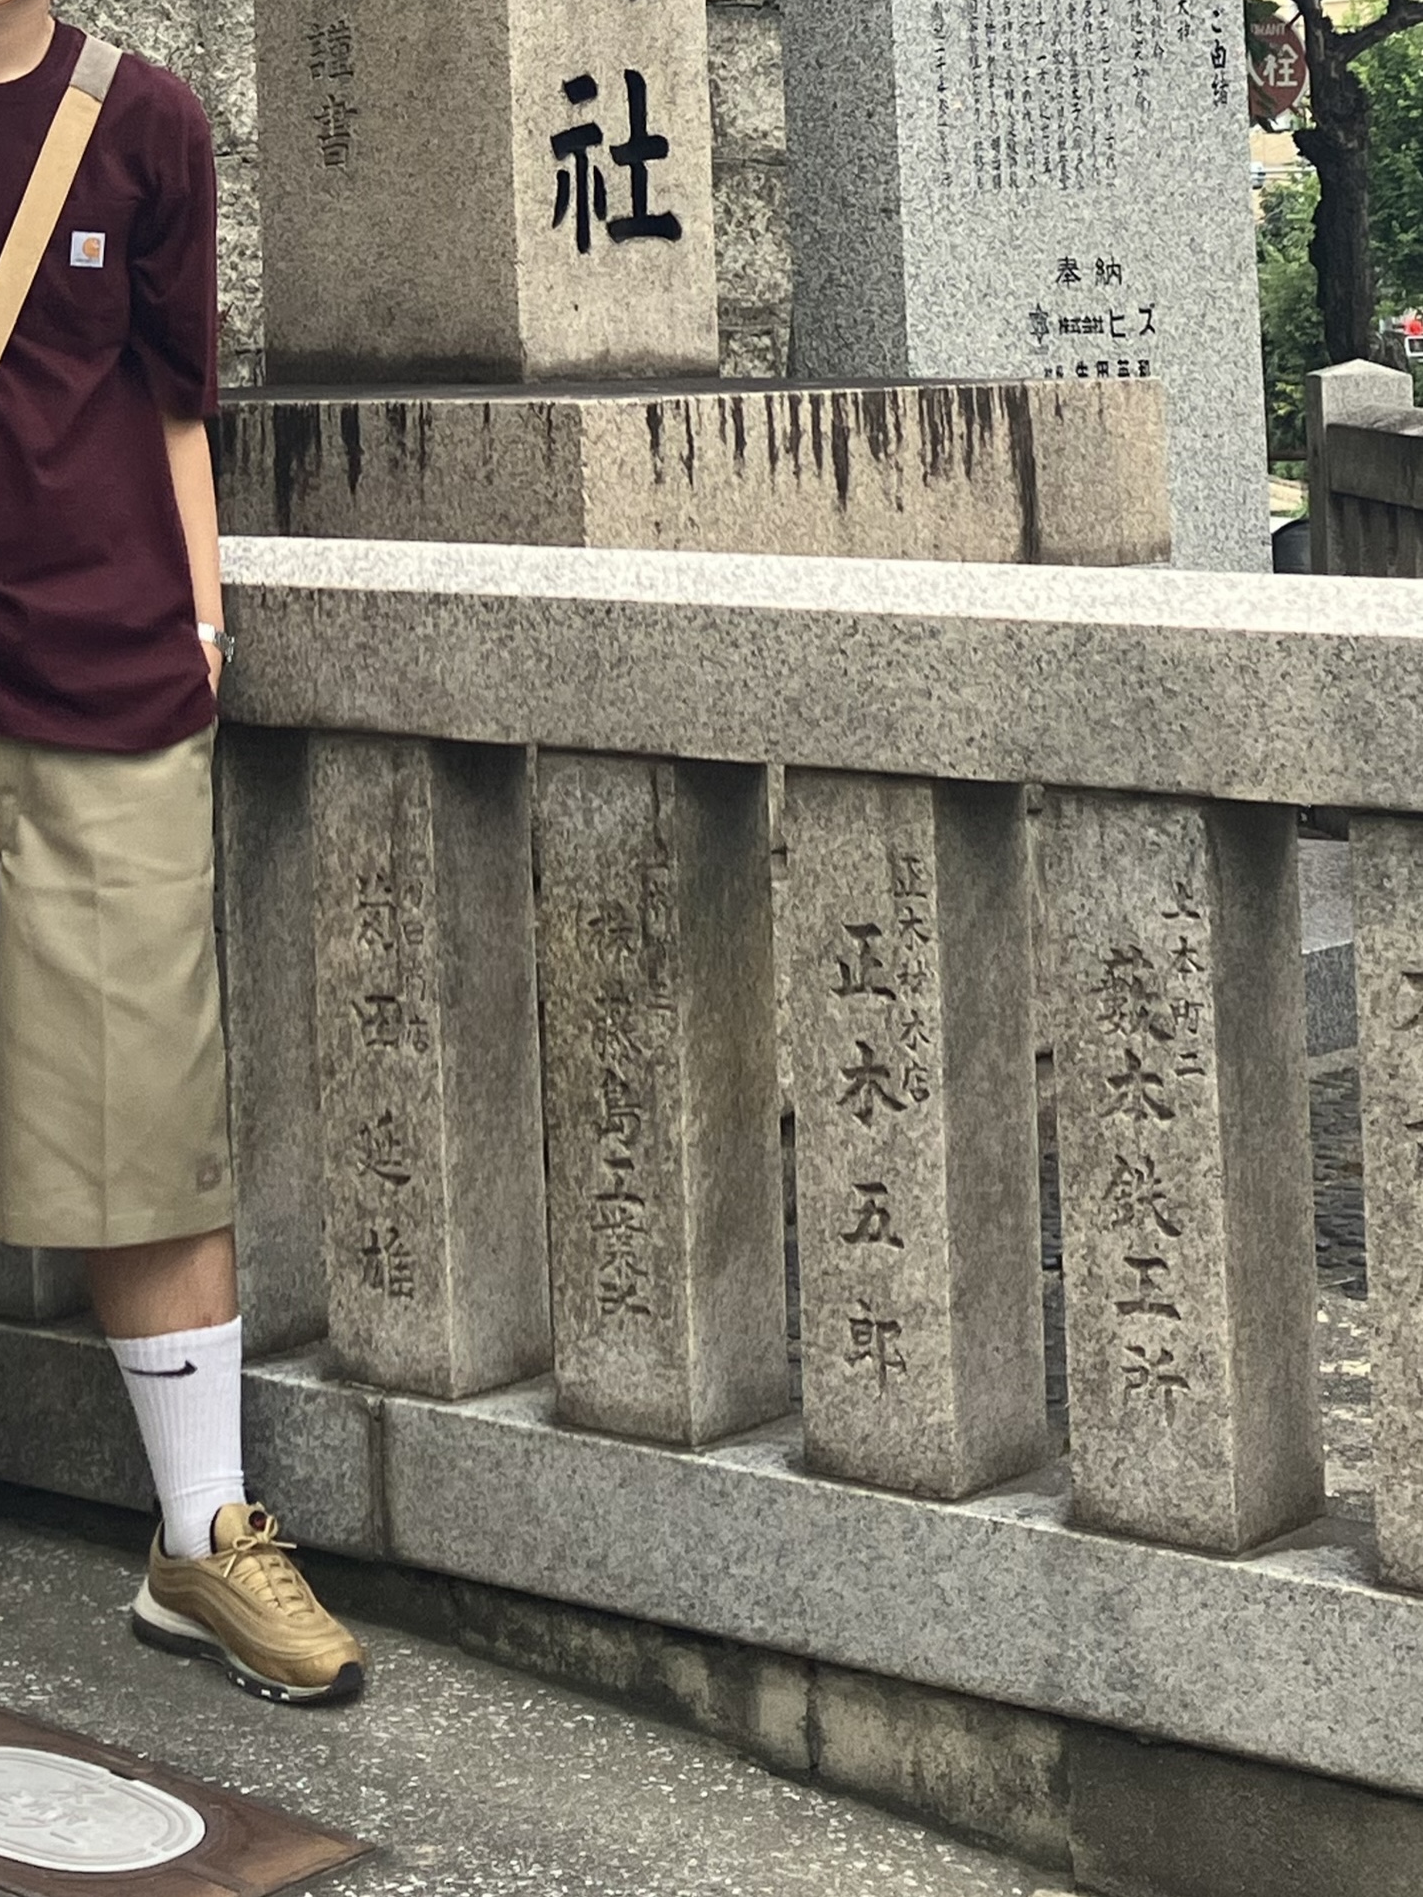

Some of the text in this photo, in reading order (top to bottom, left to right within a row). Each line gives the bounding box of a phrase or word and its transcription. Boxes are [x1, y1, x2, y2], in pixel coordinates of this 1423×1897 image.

[1055, 255, 1123, 289] 奉納
[1161, 881, 1205, 1080] 上本町二
[828, 923, 908, 1399] 正木五郎
